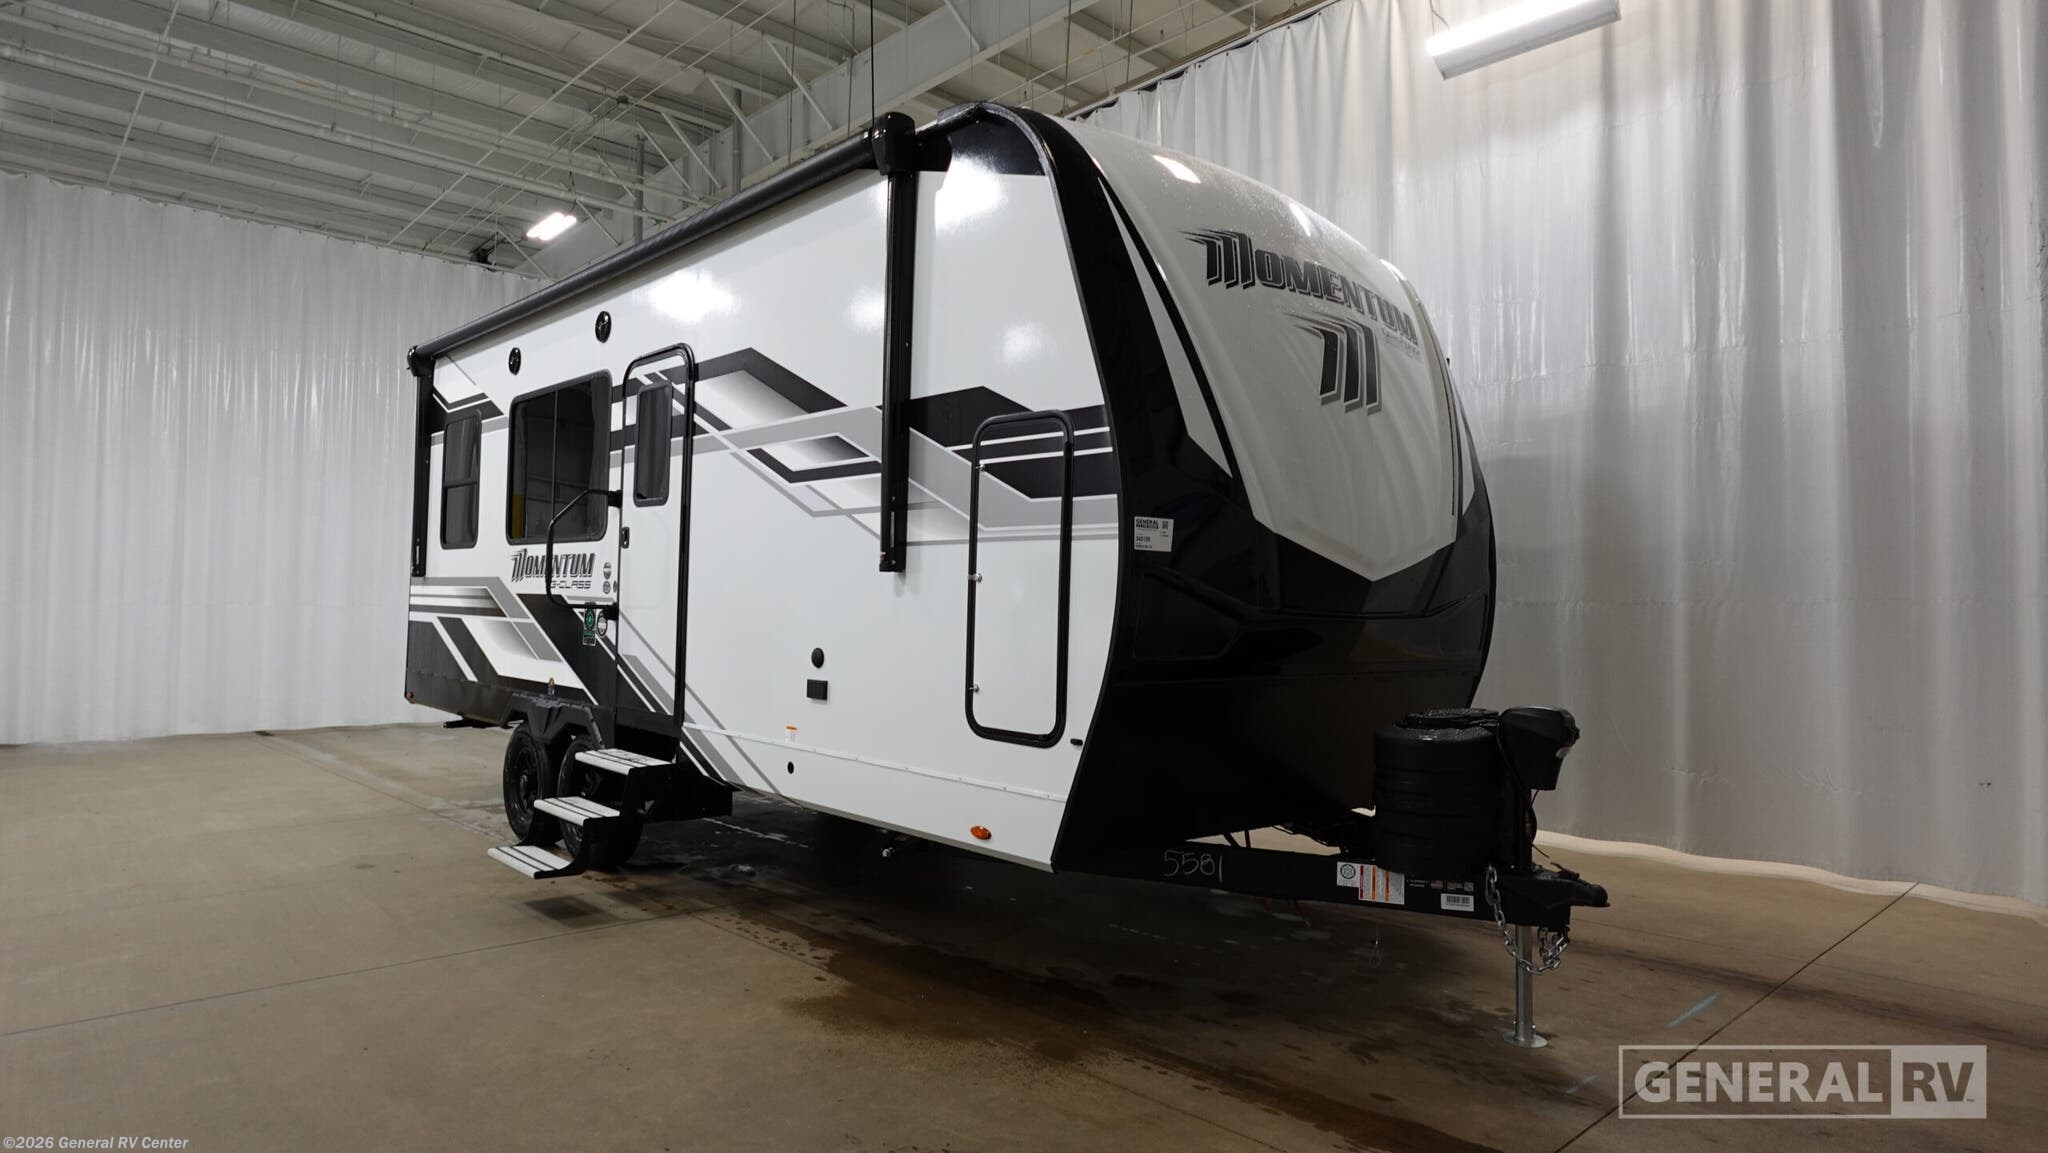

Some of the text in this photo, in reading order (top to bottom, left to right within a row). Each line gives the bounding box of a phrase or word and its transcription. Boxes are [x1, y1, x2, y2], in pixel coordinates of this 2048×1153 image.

[1178, 228, 1419, 347] MOMENTUM
[511, 548, 596, 582] MOMNTUM
[1162, 849, 1223, 884] 5581
